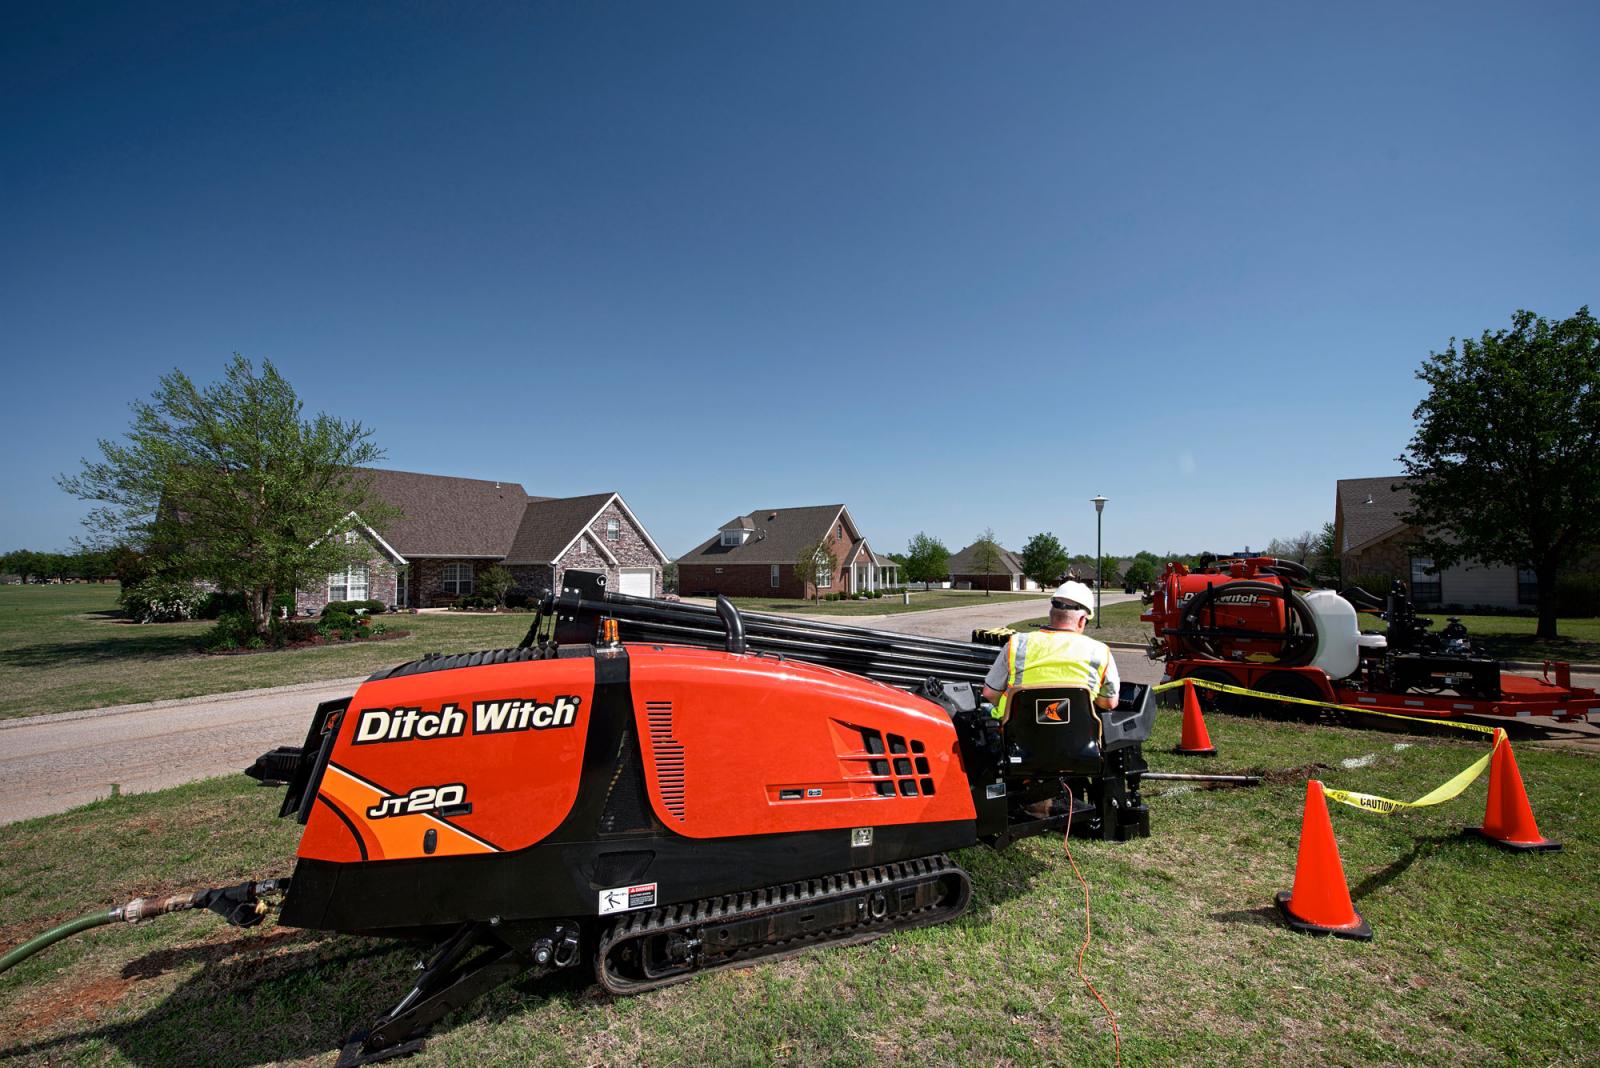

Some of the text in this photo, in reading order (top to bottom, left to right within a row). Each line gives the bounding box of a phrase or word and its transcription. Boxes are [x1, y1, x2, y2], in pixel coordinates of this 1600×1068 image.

[357, 698, 575, 742] Ditch Witch
[369, 785, 465, 817] JT20
[1360, 797, 1393, 812] CAUTION
